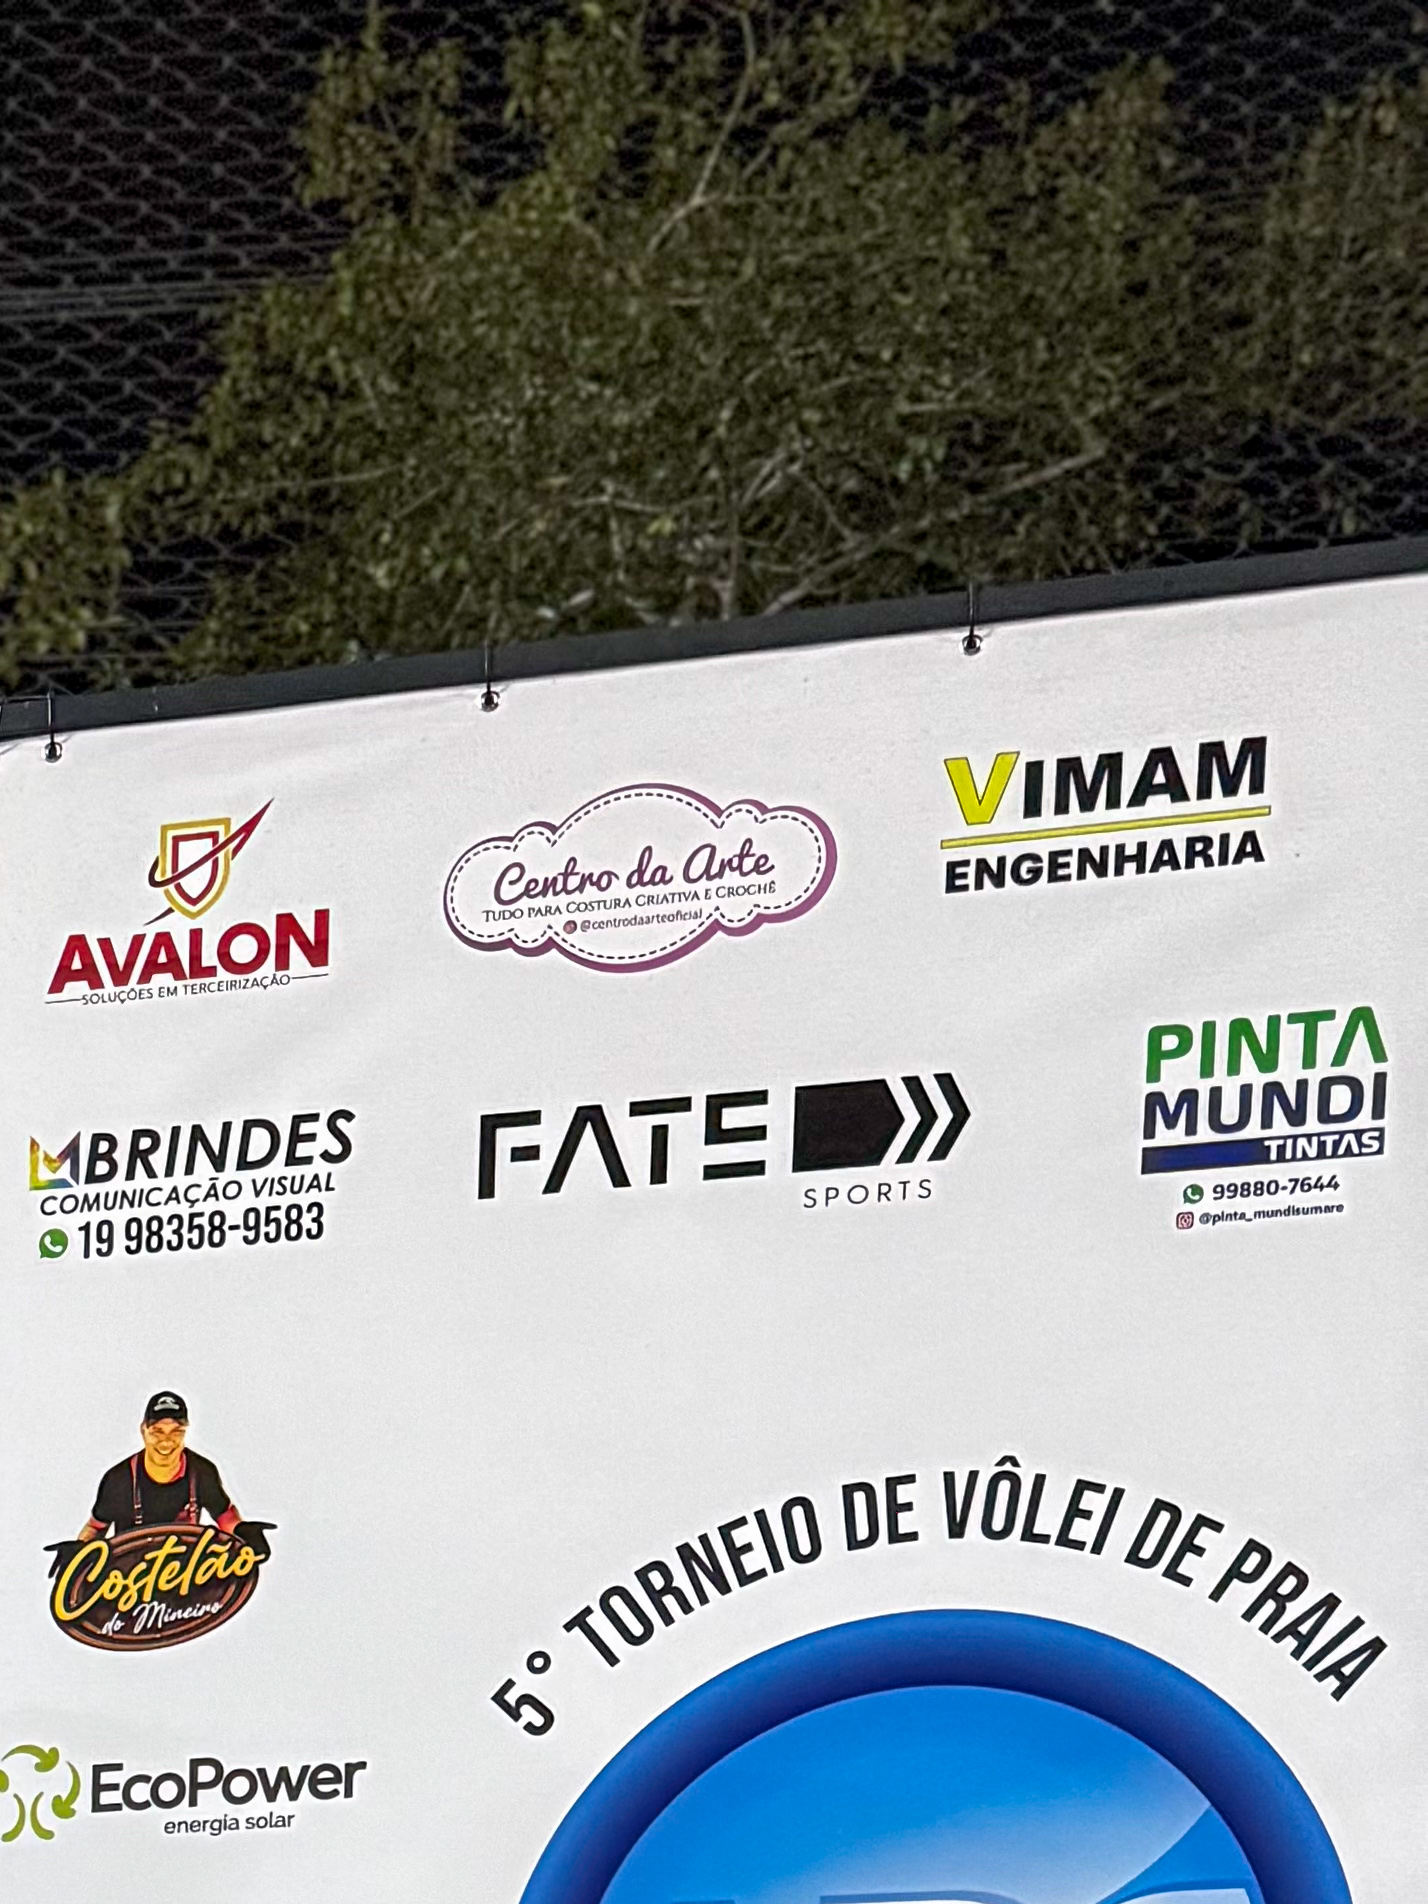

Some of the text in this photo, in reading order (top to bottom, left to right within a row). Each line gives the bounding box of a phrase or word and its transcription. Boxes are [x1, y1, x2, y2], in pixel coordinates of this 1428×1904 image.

[944, 736, 1267, 826] VIMAM
[494, 838, 776, 906] Centro da Arte
[945, 830, 1265, 894] ENGENHARIA
[482, 908, 524, 923] TUDO
[527, 904, 562, 918] PARA
[566, 897, 632, 914] COSTURA
[635, 891, 701, 908] CRIATIVA
[704, 888, 712, 900] E
[580, 908, 704, 933] @centrodaarteoficial
[47, 908, 331, 995] AVALON
[81, 972, 291, 1006] SOLUÇÕES EM TERCEIRIZAÇÃO
[1145, 1006, 1388, 1083] PINTA
[1143, 1071, 1388, 1140] MUNDI
[477, 1089, 769, 1200] FATE
[1263, 1131, 1381, 1162] TINTAS
[39, 1172, 336, 1217] COMUNICAÇÃO VISUAL
[803, 1178, 932, 1209] SPORTS
[1199, 1202, 1345, 1227] @pinta_mundisumare
[1212, 1175, 1340, 1201] 99880-7644
[78, 1202, 325, 1259] 19 98358-9583
[54, 1527, 268, 1622] Costelão
[562, 1496, 823, 1668] TORNEIO
[841, 1473, 919, 1551] DE
[943, 1454, 1126, 1556] VÔLEI
[1124, 1497, 1225, 1588] DE
[1208, 1538, 1388, 1702] PRAIA
[101, 1599, 224, 1636] do Mineiro
[91, 1757, 367, 1813] EcoPower
[164, 1811, 295, 1836] energia solar
